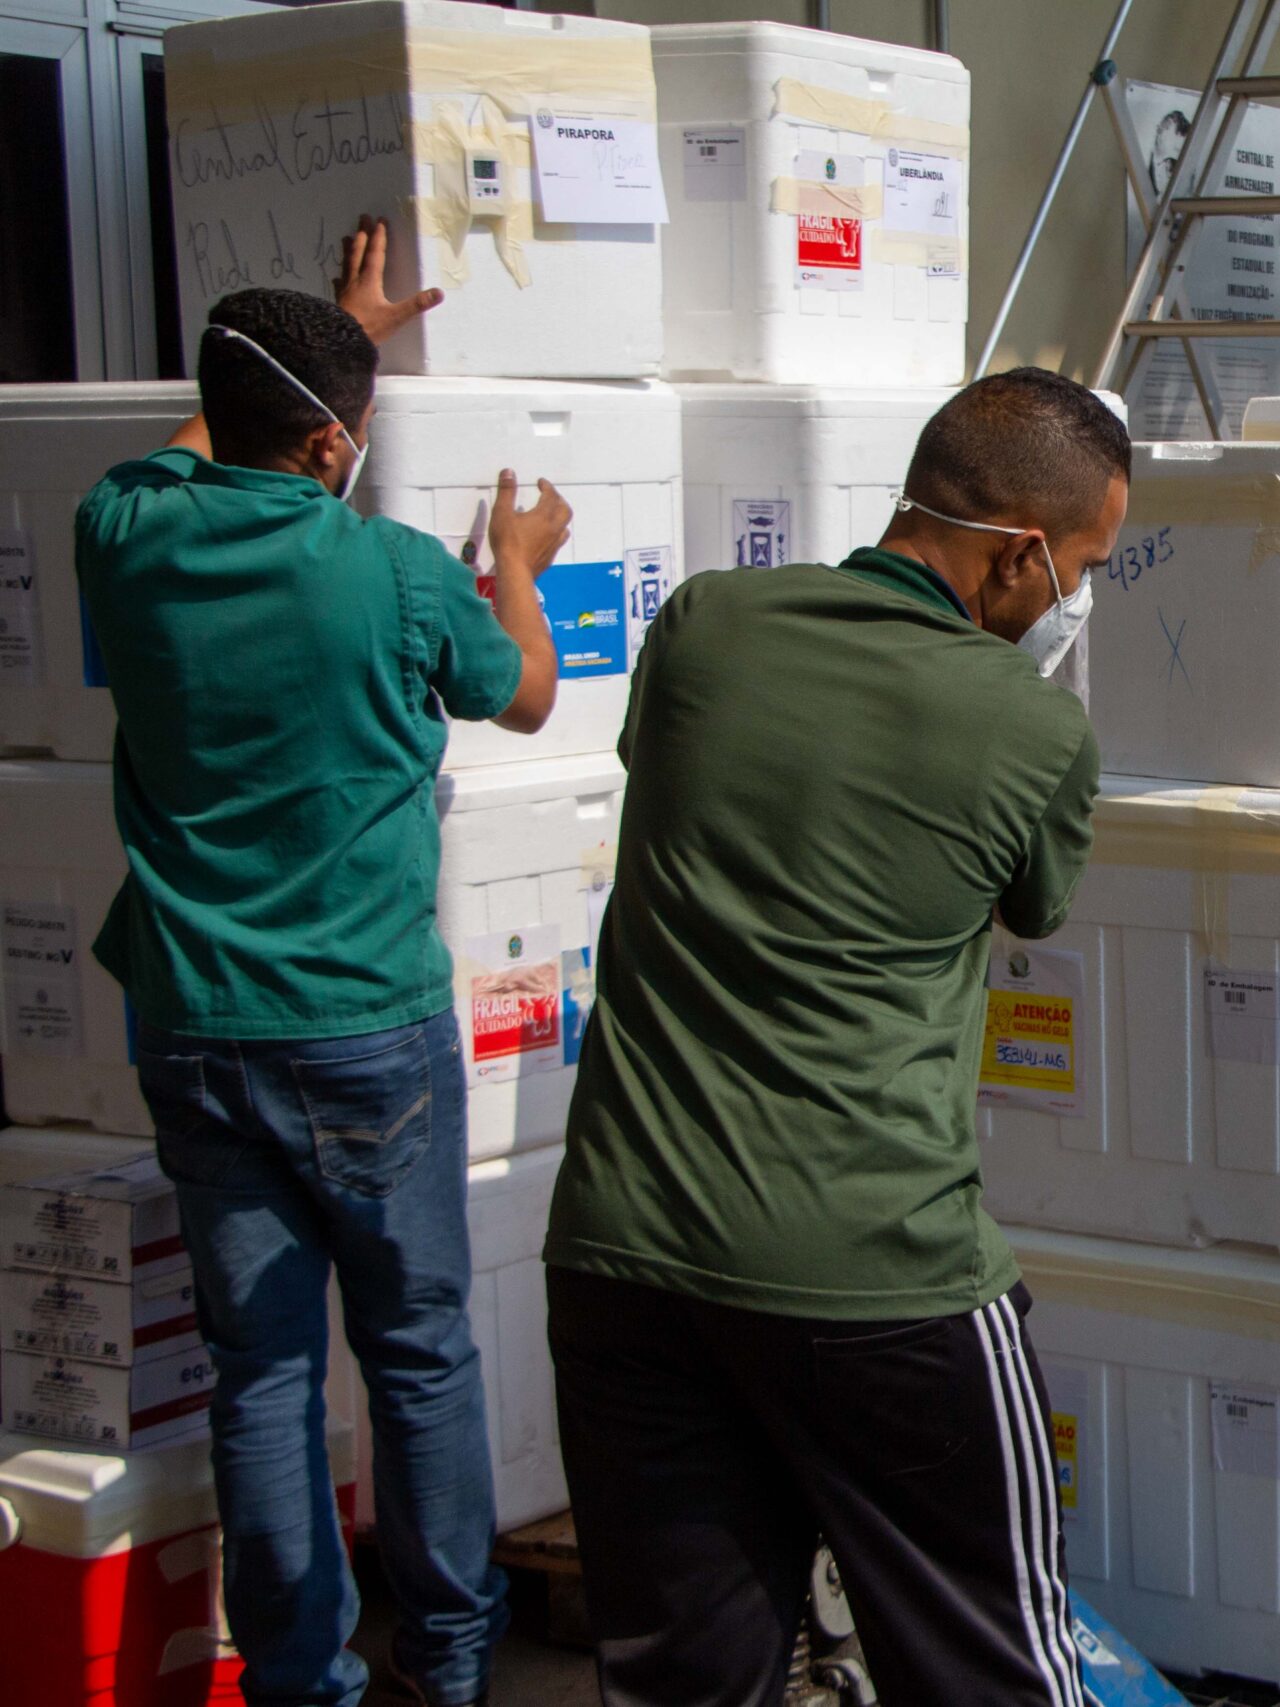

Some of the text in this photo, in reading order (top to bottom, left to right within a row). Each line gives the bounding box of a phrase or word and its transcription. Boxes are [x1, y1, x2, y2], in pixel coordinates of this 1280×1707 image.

[557, 127, 615, 140] PIRAPORA
[1108, 526, 1174, 591] 4385
[1014, 1003, 1071, 1025] ATENÇÃO
[474, 1015, 523, 1035] CUIDADO
